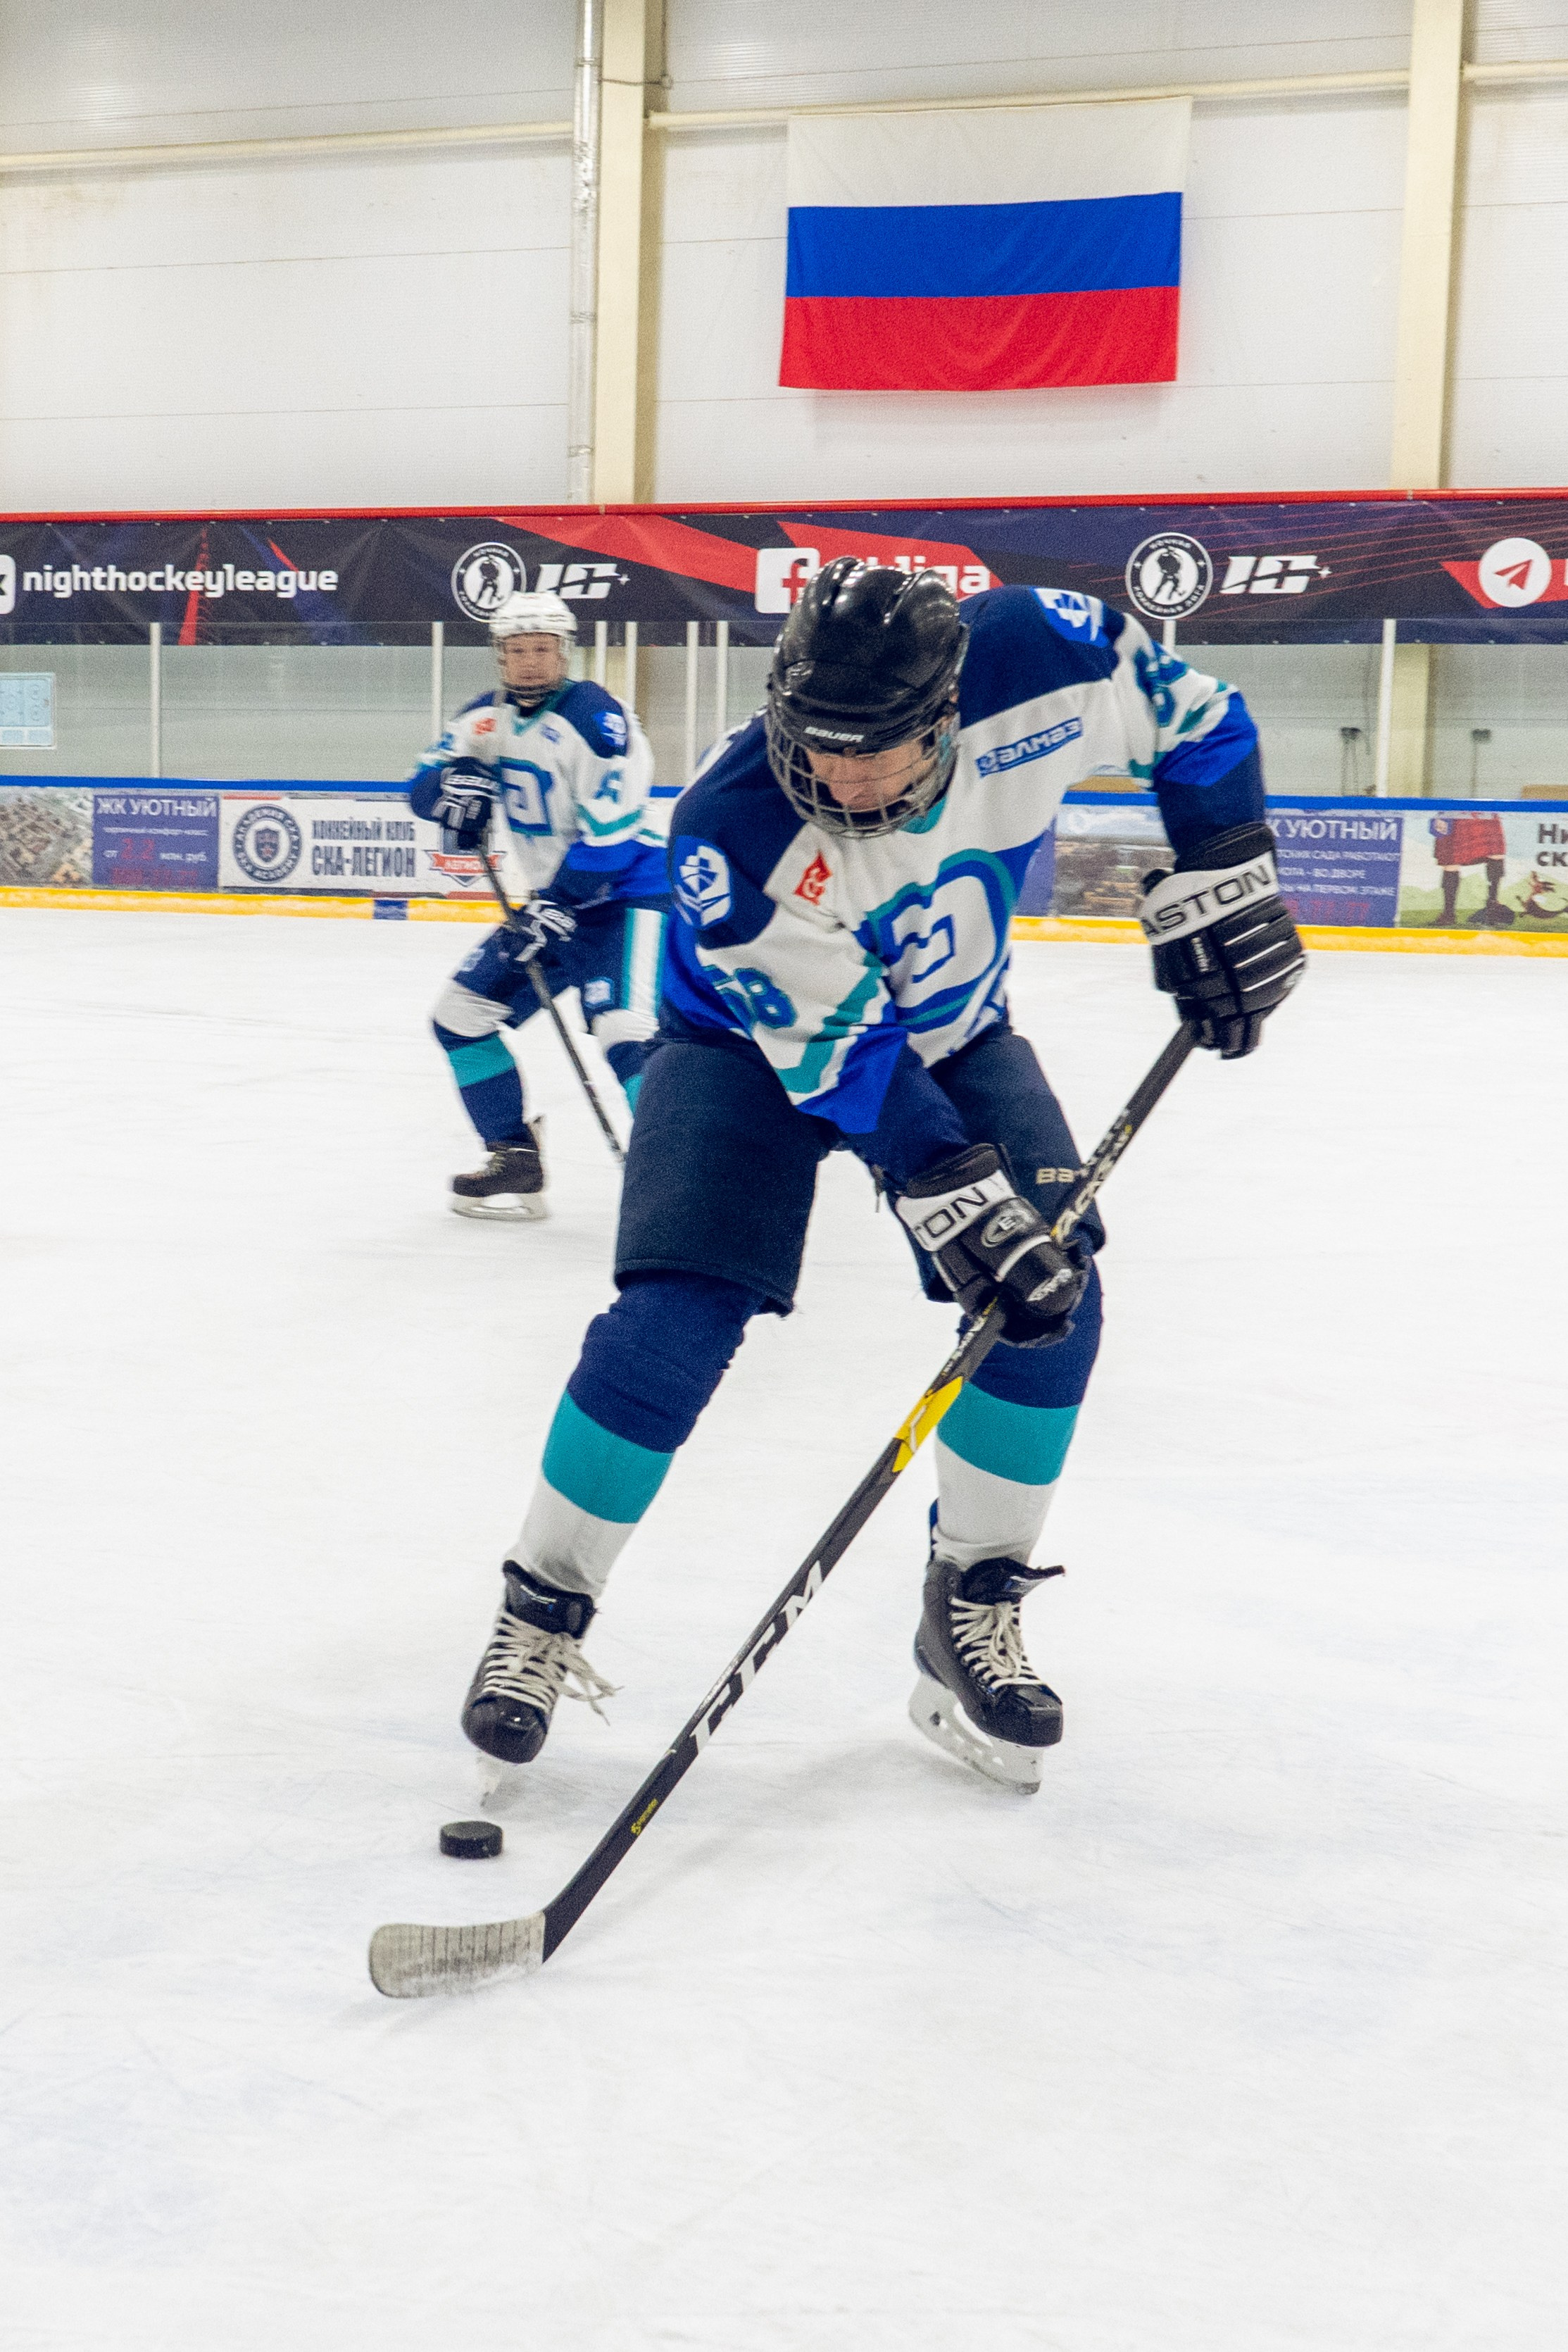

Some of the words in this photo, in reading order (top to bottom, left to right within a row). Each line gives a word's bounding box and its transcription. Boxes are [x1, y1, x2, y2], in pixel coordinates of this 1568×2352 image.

[23, 564, 339, 598] nighthockeyleague
[96, 797, 127, 815] ЖК
[129, 796, 217, 818] УЮТНЫЙ
[312, 816, 382, 840] ХОККЕЙНЫЙ
[386, 820, 415, 841] КЛУБ
[1286, 818, 1398, 841] УЮТНЫЙ
[312, 845, 415, 877] СКА-ЛЕГИОН
[1140, 863, 1271, 938] ASTON
